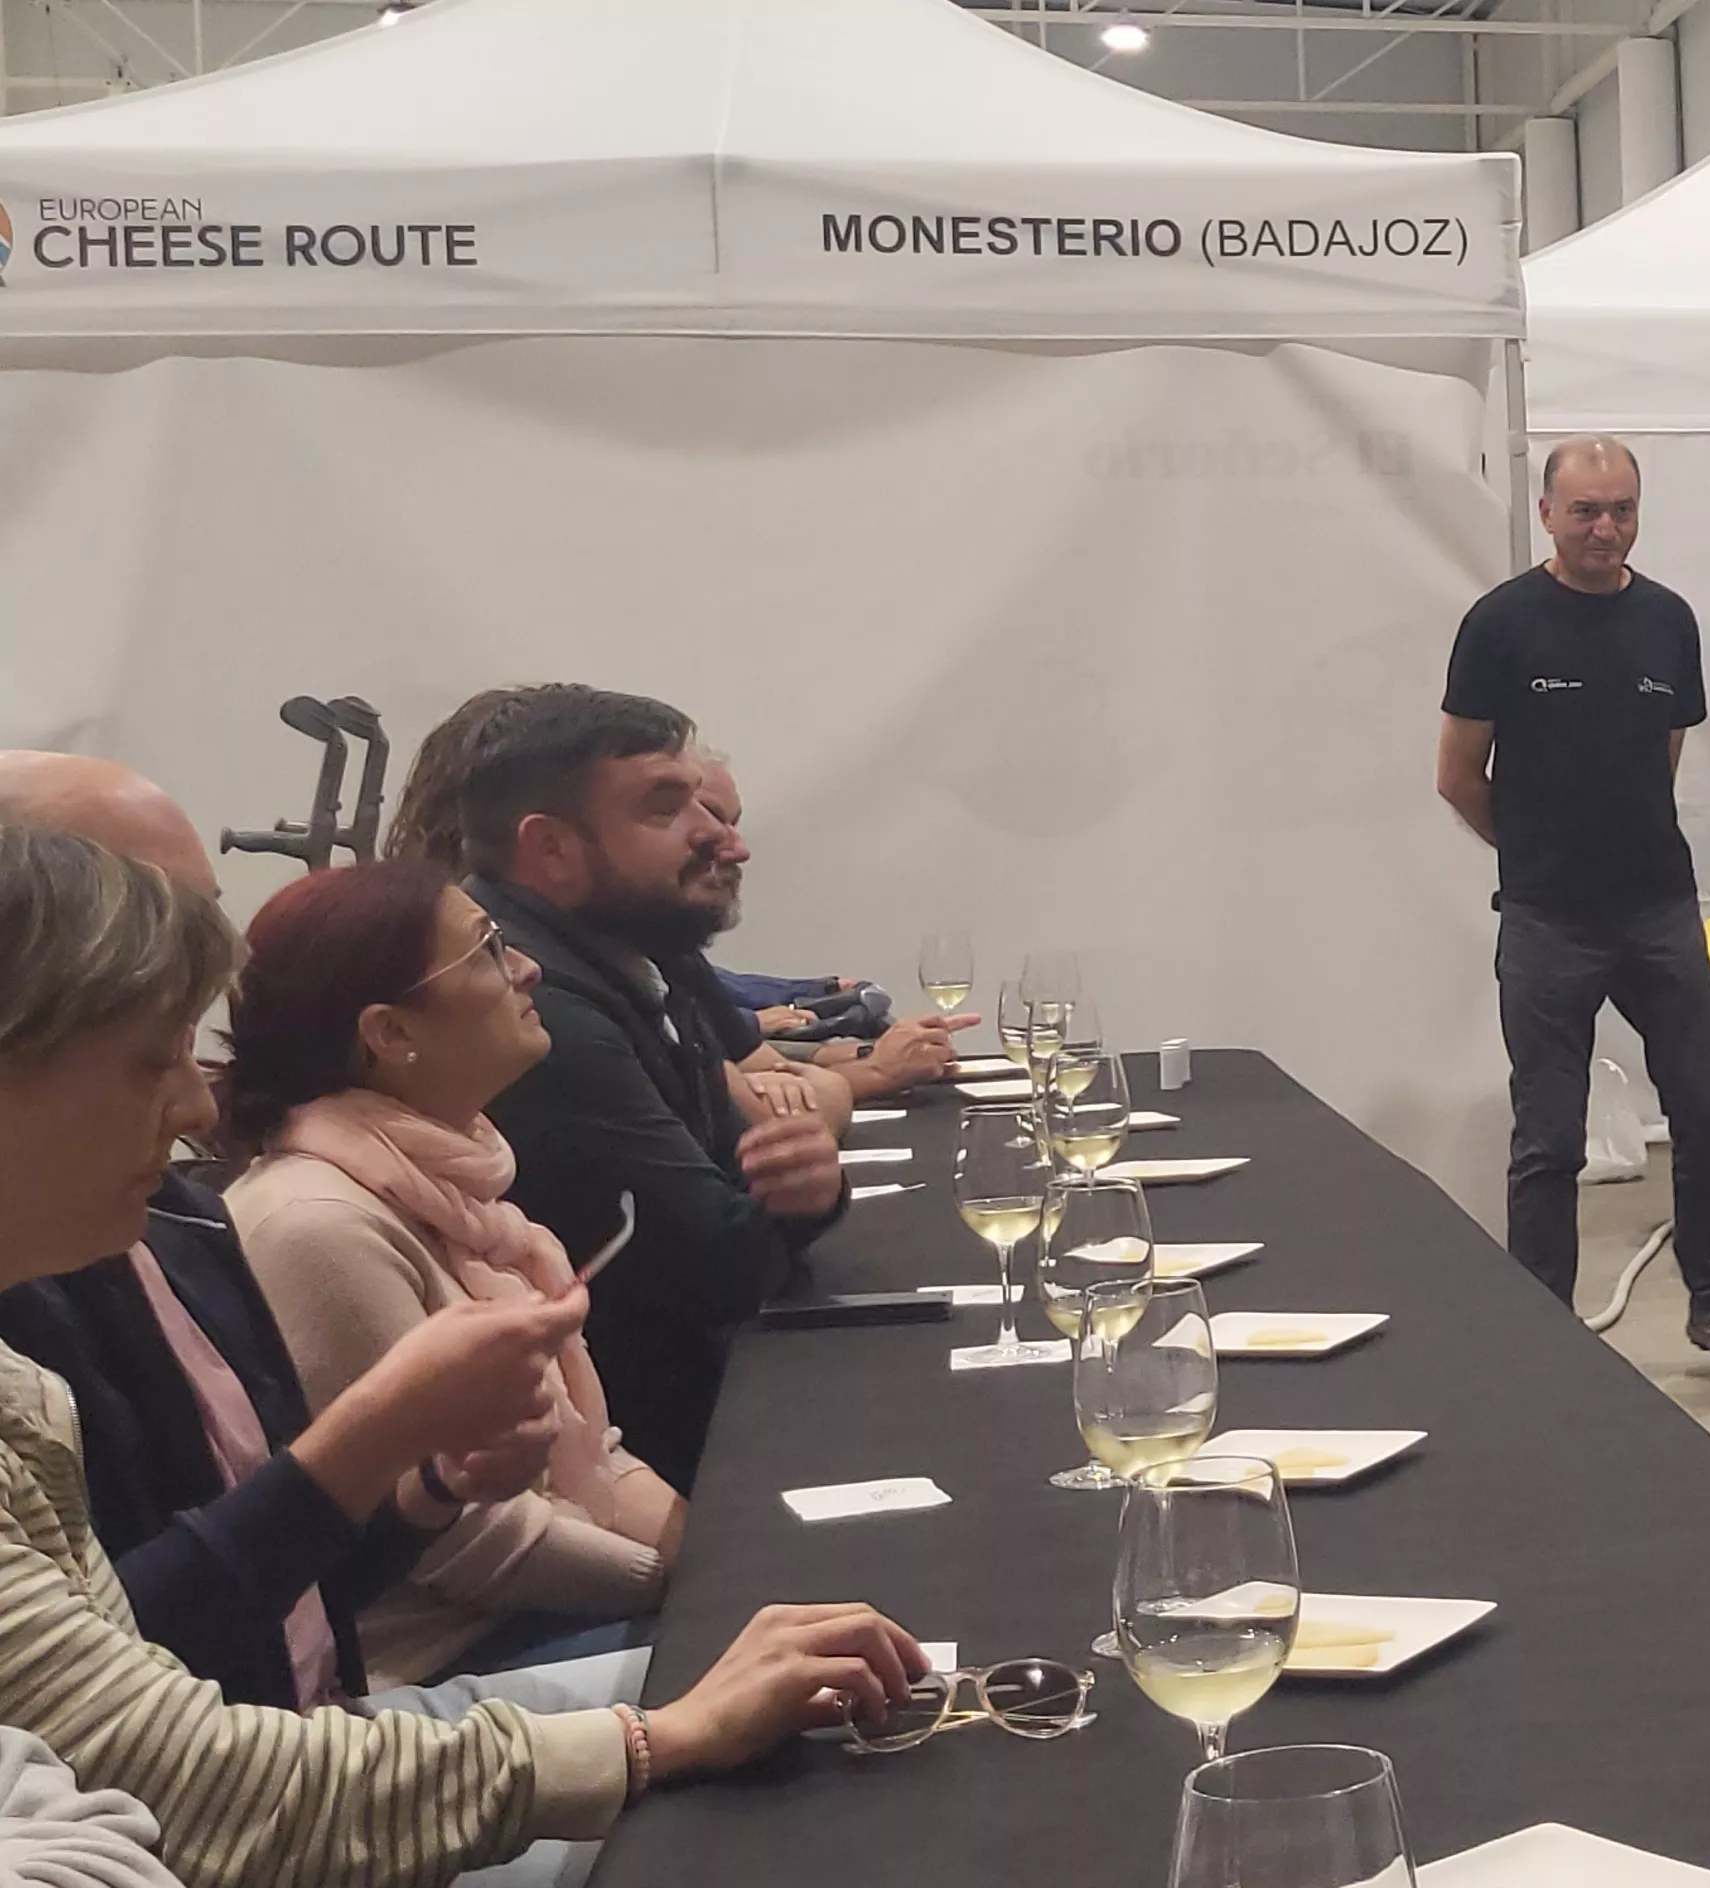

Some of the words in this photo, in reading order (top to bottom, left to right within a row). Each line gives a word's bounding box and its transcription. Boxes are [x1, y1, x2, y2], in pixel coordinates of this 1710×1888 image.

[39, 197, 203, 222] EUROPEAN
[33, 224, 264, 269] CHEESE
[285, 224, 478, 267] ROUTE
[822, 213, 1182, 258] MONESTERIO
[1200, 217, 1468, 268] (BADAJOZ)
